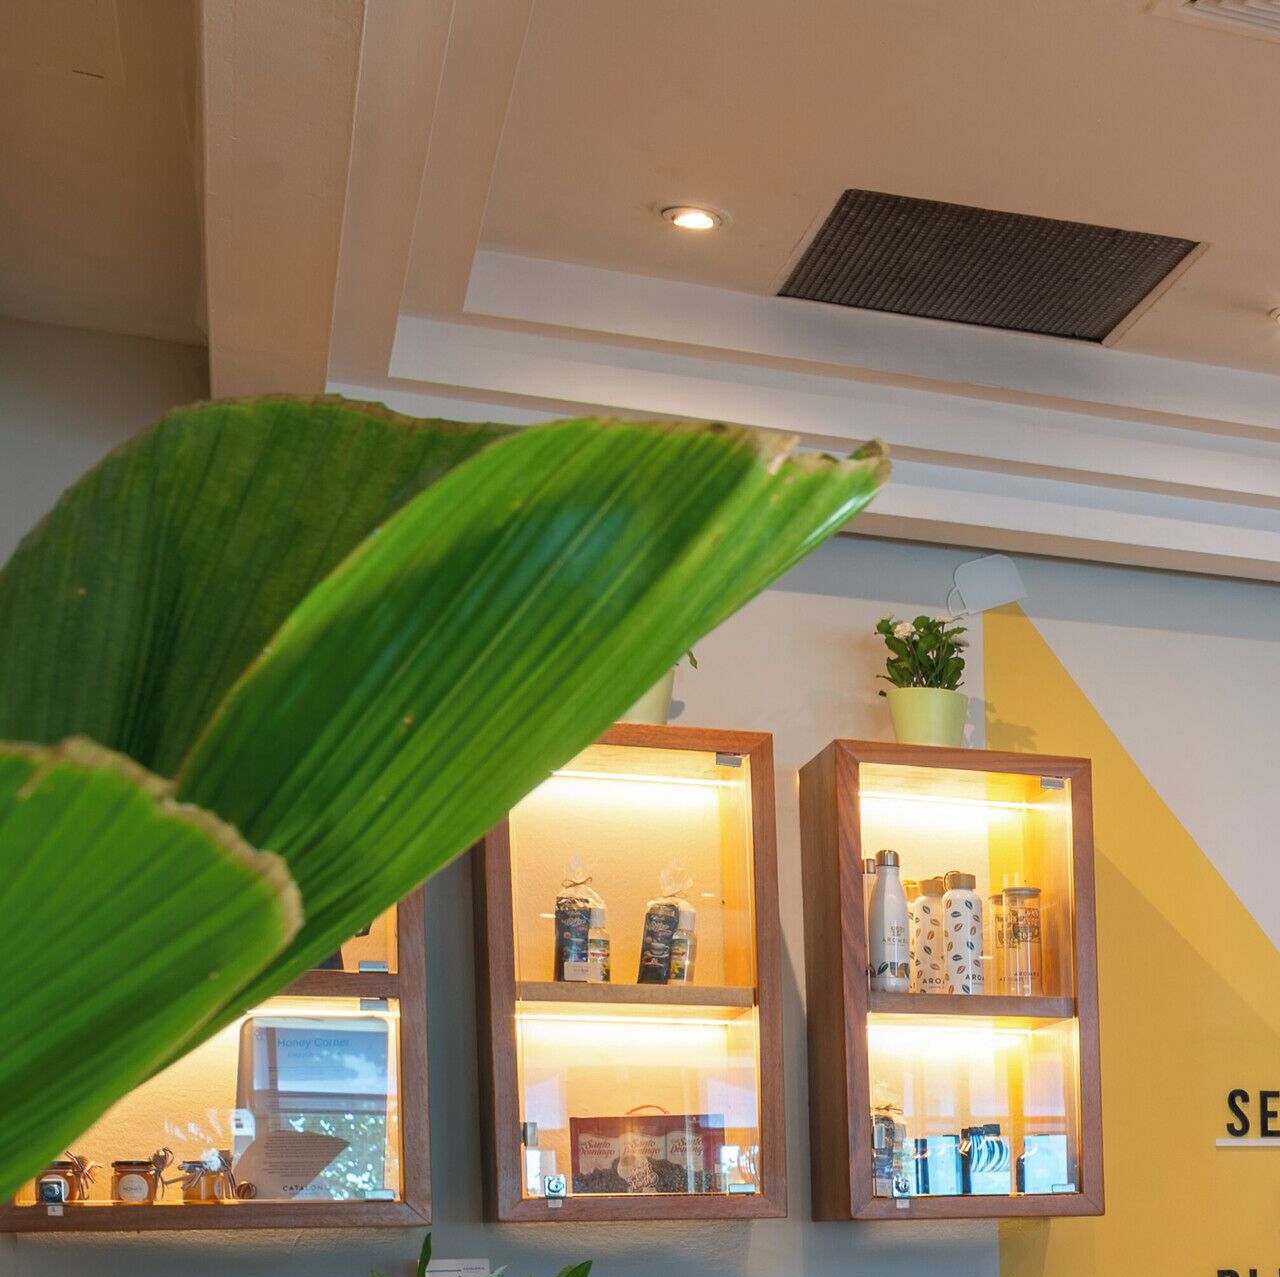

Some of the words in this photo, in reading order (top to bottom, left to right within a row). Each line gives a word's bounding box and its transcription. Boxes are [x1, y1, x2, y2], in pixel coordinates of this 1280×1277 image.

[277, 1038, 312, 1049] Honey
[314, 1038, 350, 1048] Corner
[585, 1139, 611, 1148] Santo
[632, 1137, 656, 1148] Santo
[580, 1147, 615, 1158] Domingo
